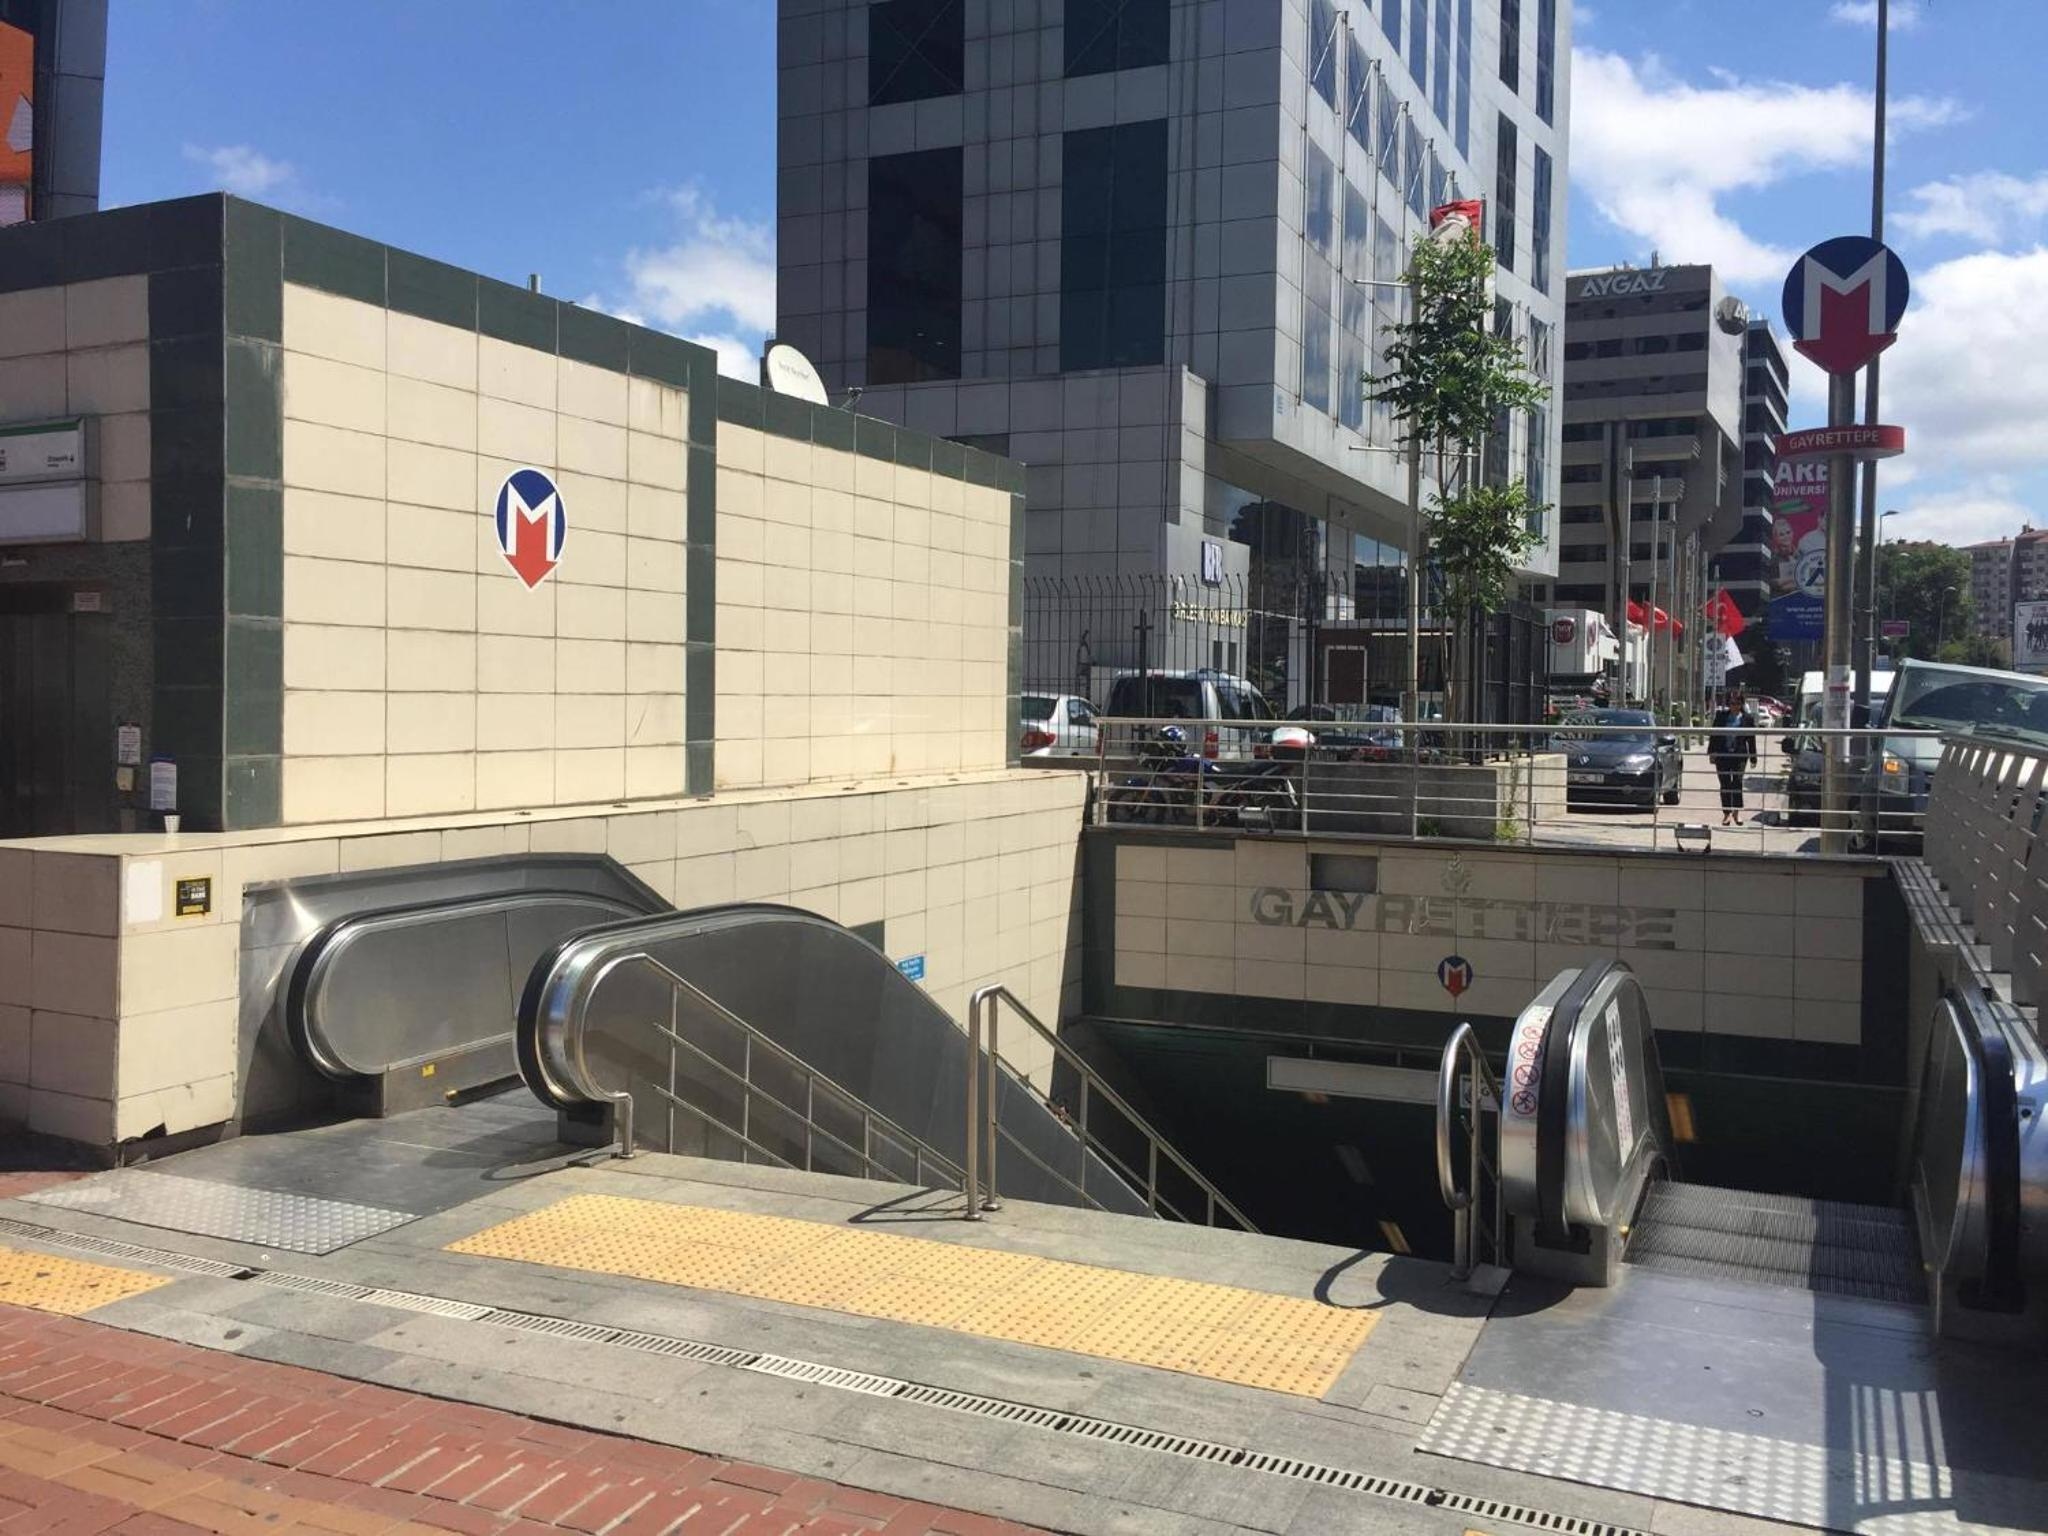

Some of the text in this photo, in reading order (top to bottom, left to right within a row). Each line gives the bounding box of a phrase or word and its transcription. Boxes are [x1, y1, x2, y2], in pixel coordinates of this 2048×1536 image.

[1579, 270, 1668, 297] AYGAZ
[1789, 430, 1879, 449] GAYRETTEPE
[1251, 887, 1676, 950] GAYRETTEPE
